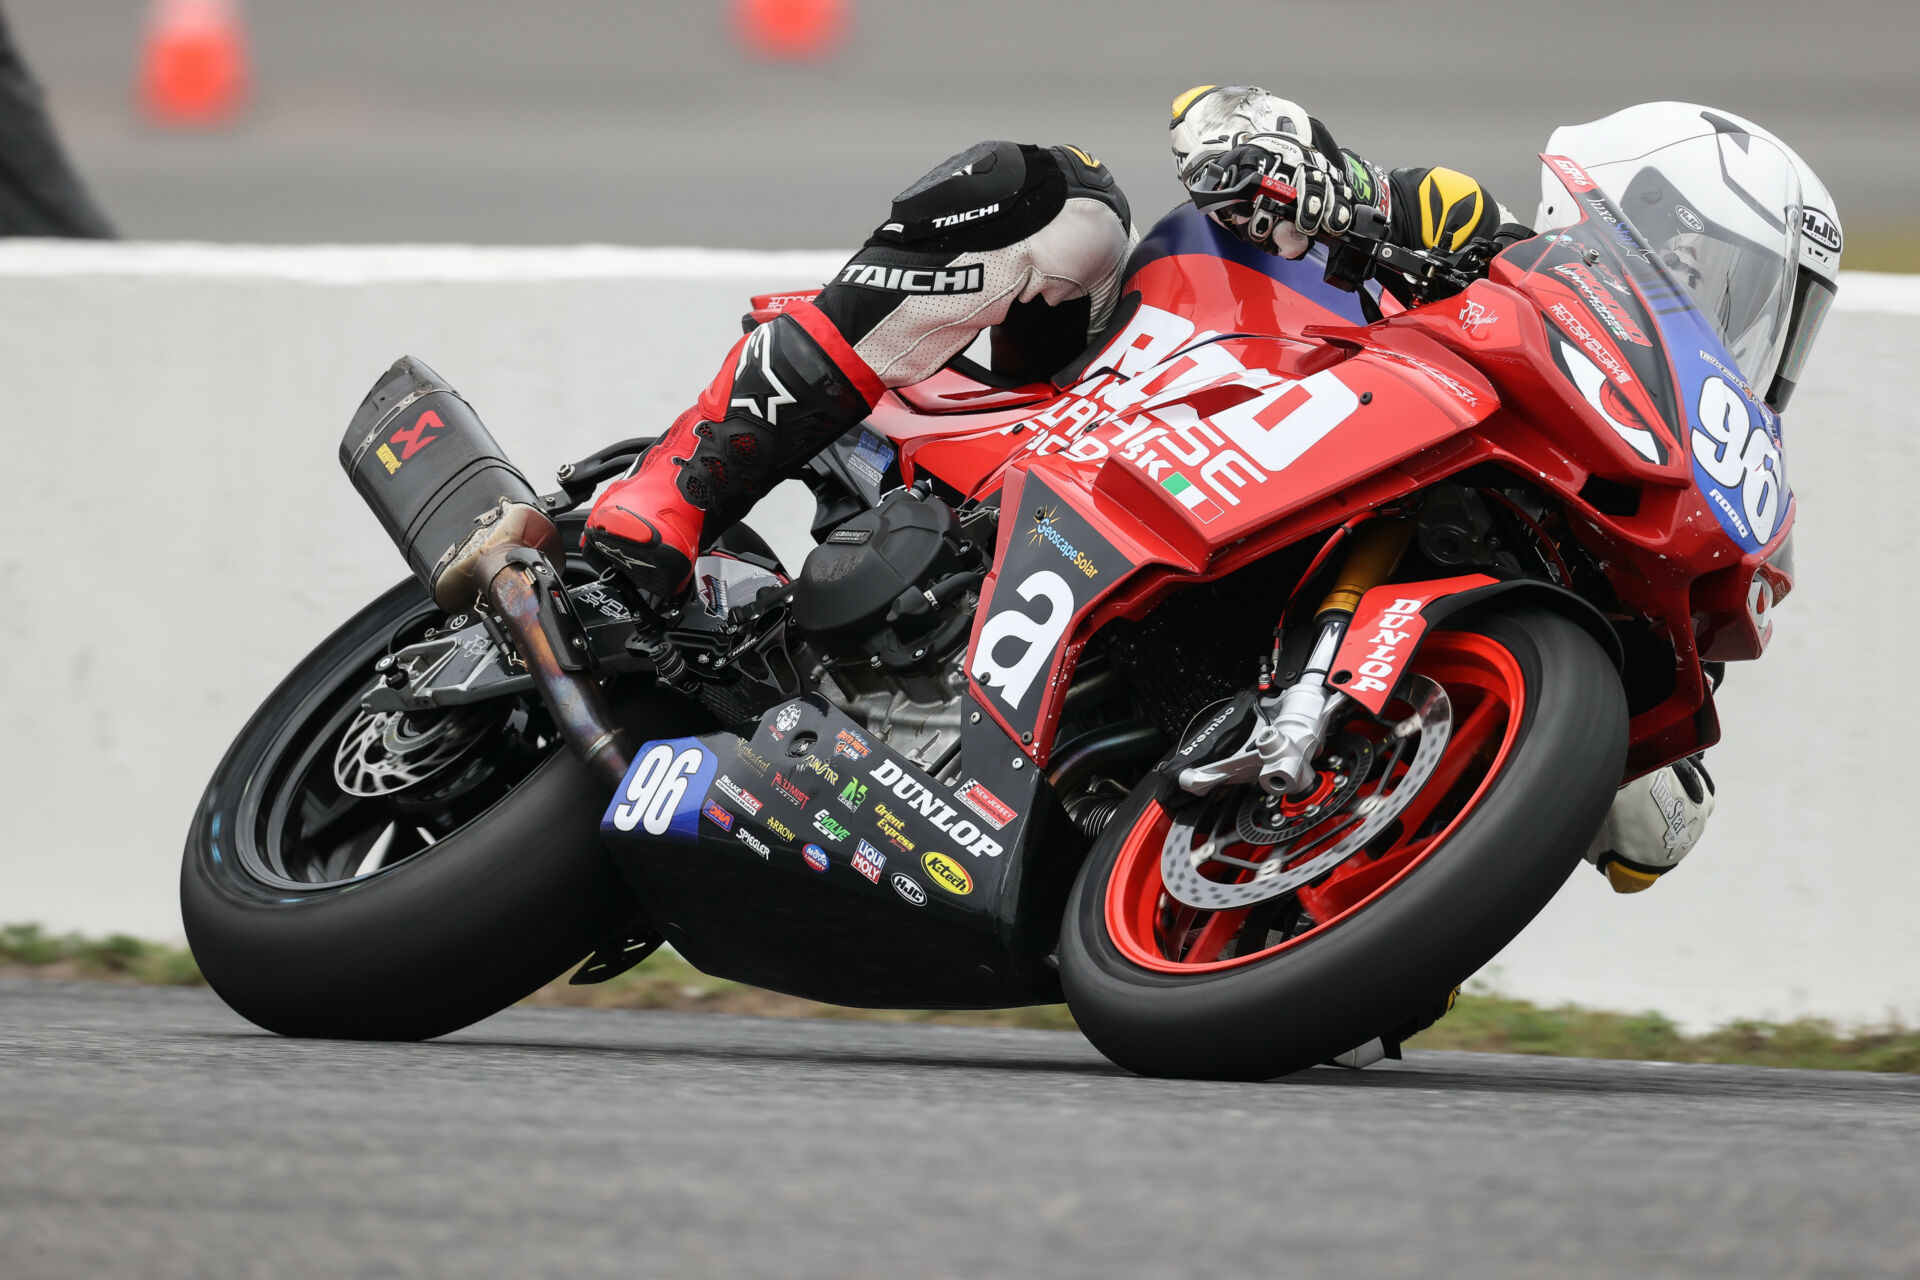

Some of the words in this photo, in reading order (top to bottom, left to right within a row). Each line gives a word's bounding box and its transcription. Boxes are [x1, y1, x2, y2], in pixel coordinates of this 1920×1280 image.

[931, 203, 1000, 229] TAICHI
[1679, 208, 1703, 229] HJC
[1801, 210, 1840, 243] HJC
[841, 264, 982, 292] TAICHI
[1691, 375, 1781, 546] 96
[1709, 488, 1749, 539] RODIO
[971, 570, 1075, 711] a
[1350, 598, 1422, 692] DUNLOP
[1179, 706, 1235, 756] brembo
[613, 744, 703, 835] 96
[720, 774, 743, 796] BRAKE
[742, 789, 763, 811] TECH
[787, 785, 810, 809] MIST
[973, 786, 989, 800] NEW
[987, 796, 1014, 819] JERSEY
[710, 805, 731, 825] DNA
[869, 758, 1004, 858] DUNLOP
[875, 803, 906, 829] Orient
[767, 816, 796, 842] ARROW
[812, 821, 843, 842] GT
[814, 809, 851, 840] EVOLVE
[877, 819, 916, 851] Express
[735, 827, 771, 860] SPIEGLER
[858, 841, 885, 868] LIQUI
[804, 853, 826, 871] LIBERTY
[852, 854, 880, 883] MOLY
[895, 878, 925, 902] HJC
